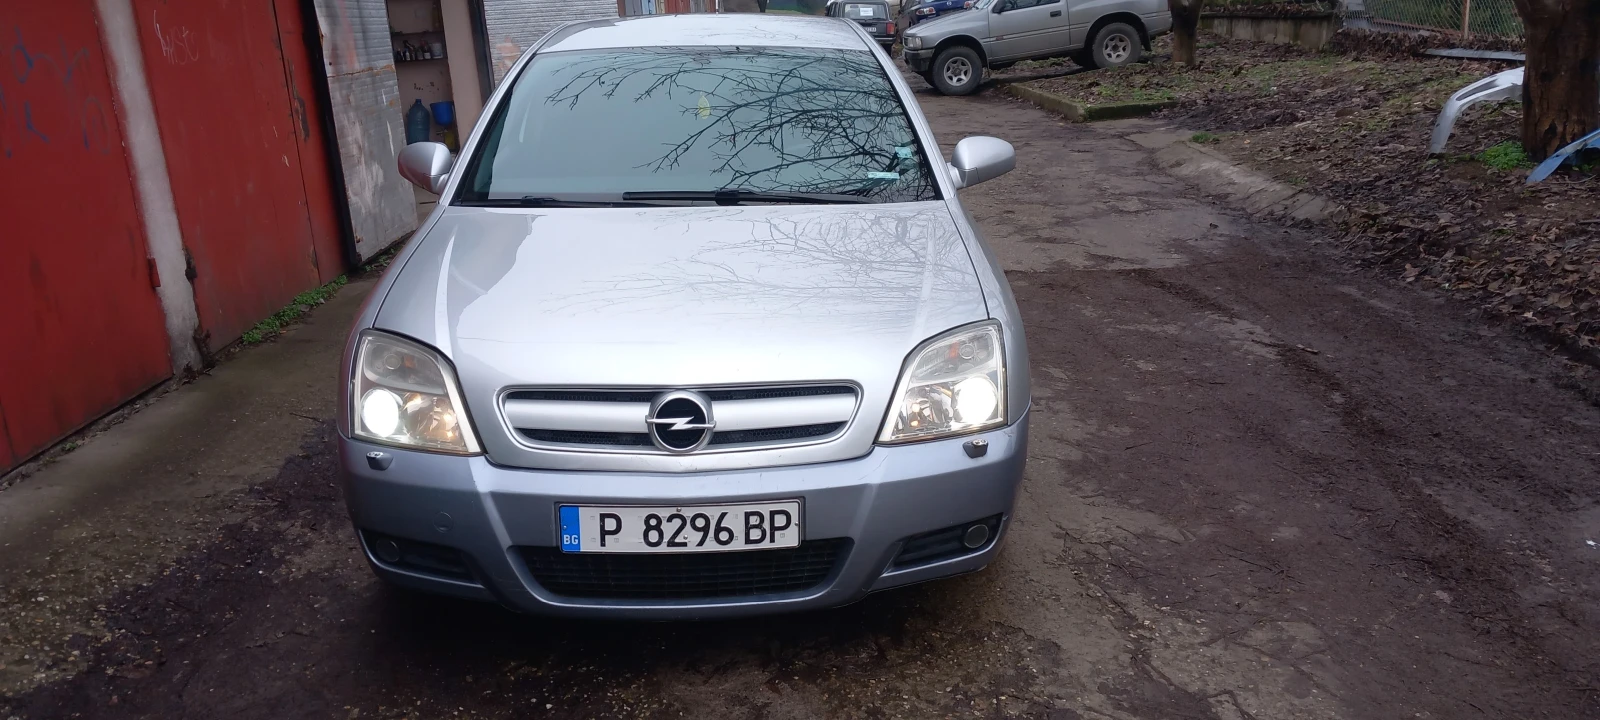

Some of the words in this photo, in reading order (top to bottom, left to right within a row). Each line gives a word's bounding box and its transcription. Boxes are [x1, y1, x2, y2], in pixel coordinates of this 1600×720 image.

[563, 534, 579, 545] BG
[599, 512, 623, 548] P
[642, 512, 735, 548] 8296
[744, 509, 792, 546] BP
